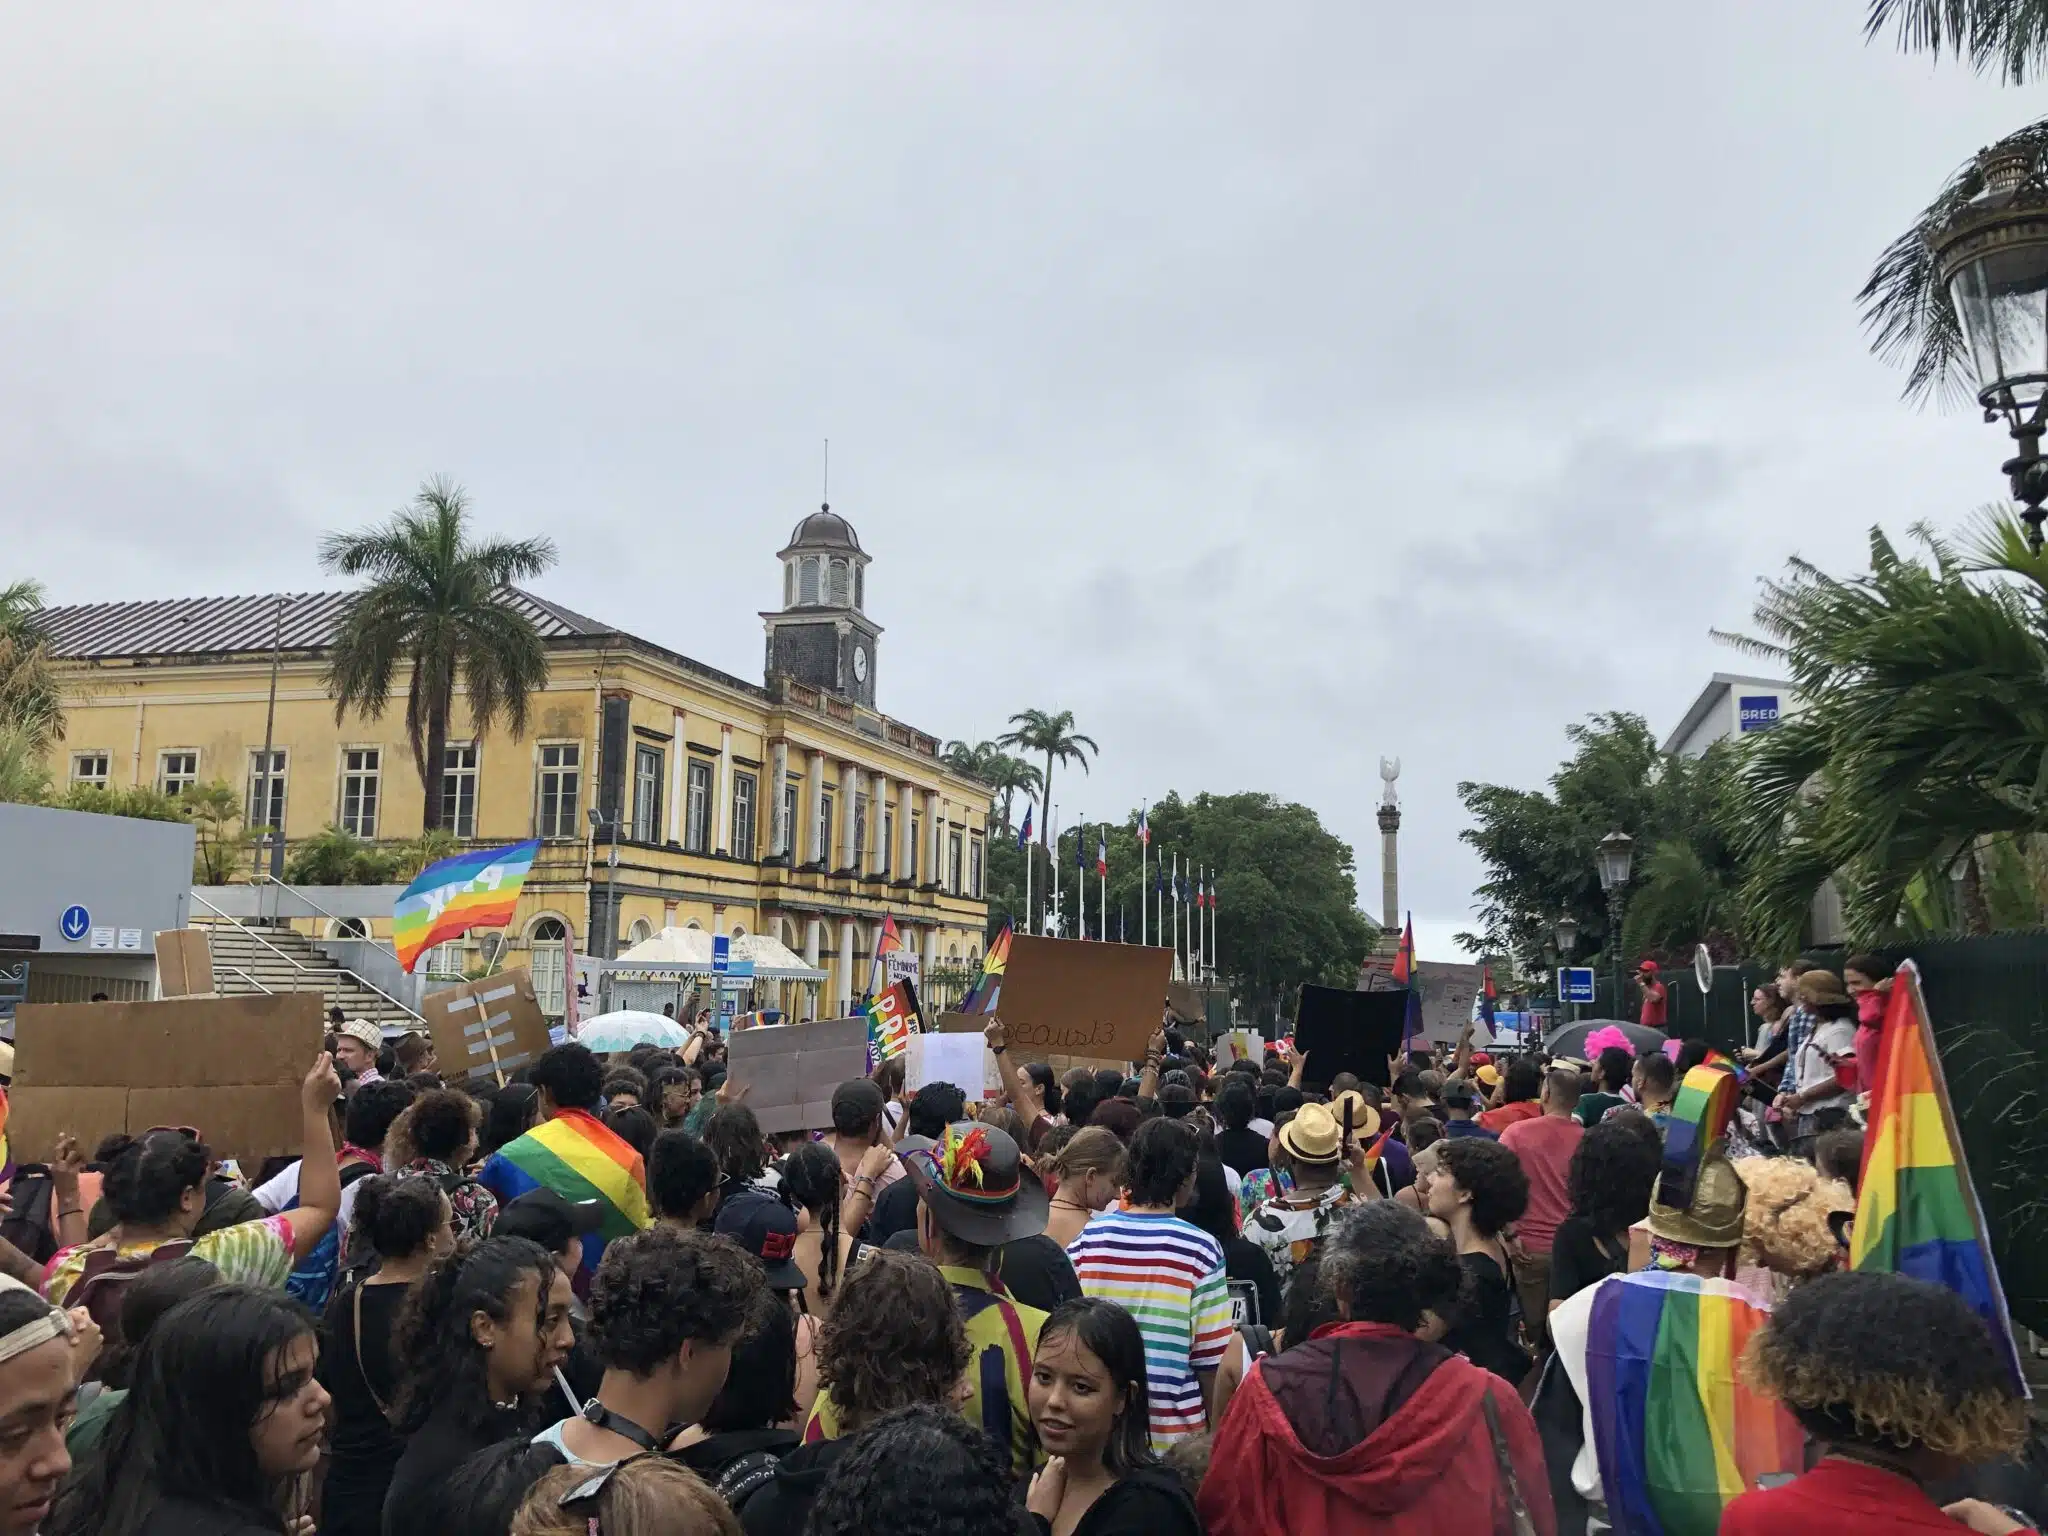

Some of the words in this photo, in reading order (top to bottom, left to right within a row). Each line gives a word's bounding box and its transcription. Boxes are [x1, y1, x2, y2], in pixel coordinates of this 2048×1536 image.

[1740, 708, 1779, 720] BRED
[868, 994, 907, 1061] PRI
[907, 1018, 918, 1035] #R
